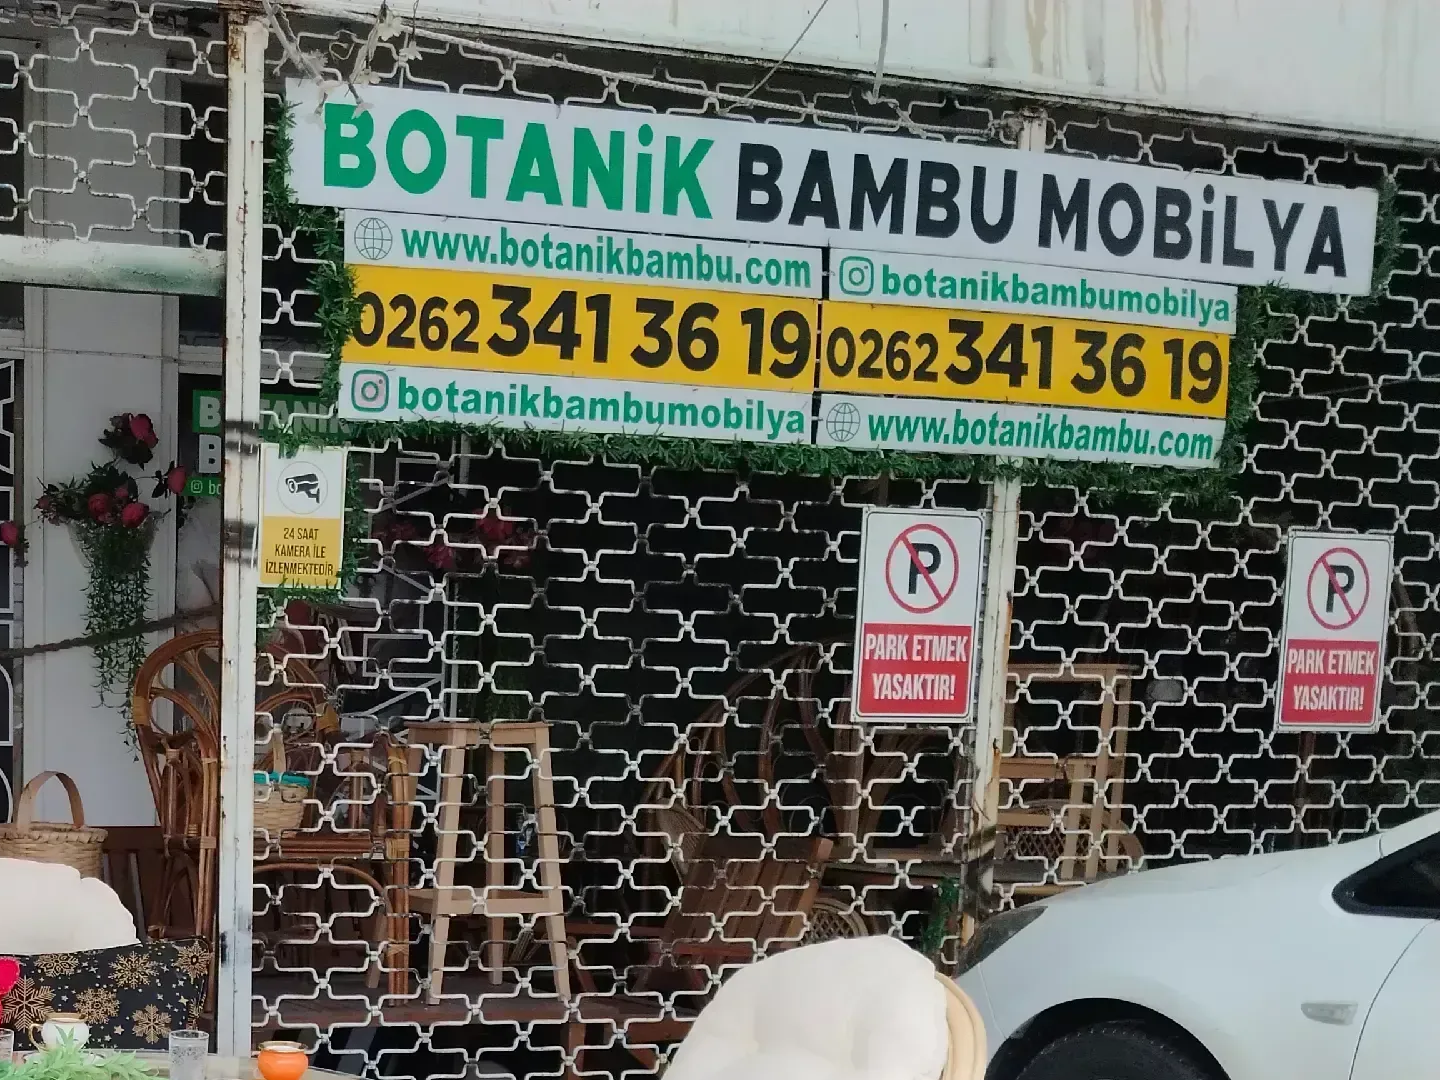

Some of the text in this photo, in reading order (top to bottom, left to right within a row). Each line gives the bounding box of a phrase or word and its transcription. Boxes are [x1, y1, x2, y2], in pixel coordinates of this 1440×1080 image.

[735, 142, 1019, 244] BAMBU
[401, 227, 811, 288] www.botanikbambu.com
[881, 264, 1230, 328] botanikbambumobilya
[353, 284, 812, 379] 0262 341 36 19
[826, 318, 1223, 404] 0262 341 36 19
[398, 378, 805, 440] botanikbambumobilya
[867, 409, 1214, 460] www.botanikbambu.com
[275, 543, 326, 559] KAMERA İLE
[283, 527, 319, 540] 24 SAAT
[265, 560, 333, 576] İZLENMEKTEDİR
[864, 633, 968, 662] PARK ETMEK
[1287, 648, 1376, 675] PARK ETMEK
[872, 673, 956, 700] YASAKTIR!
[1293, 685, 1364, 711] YASAKTIR!
